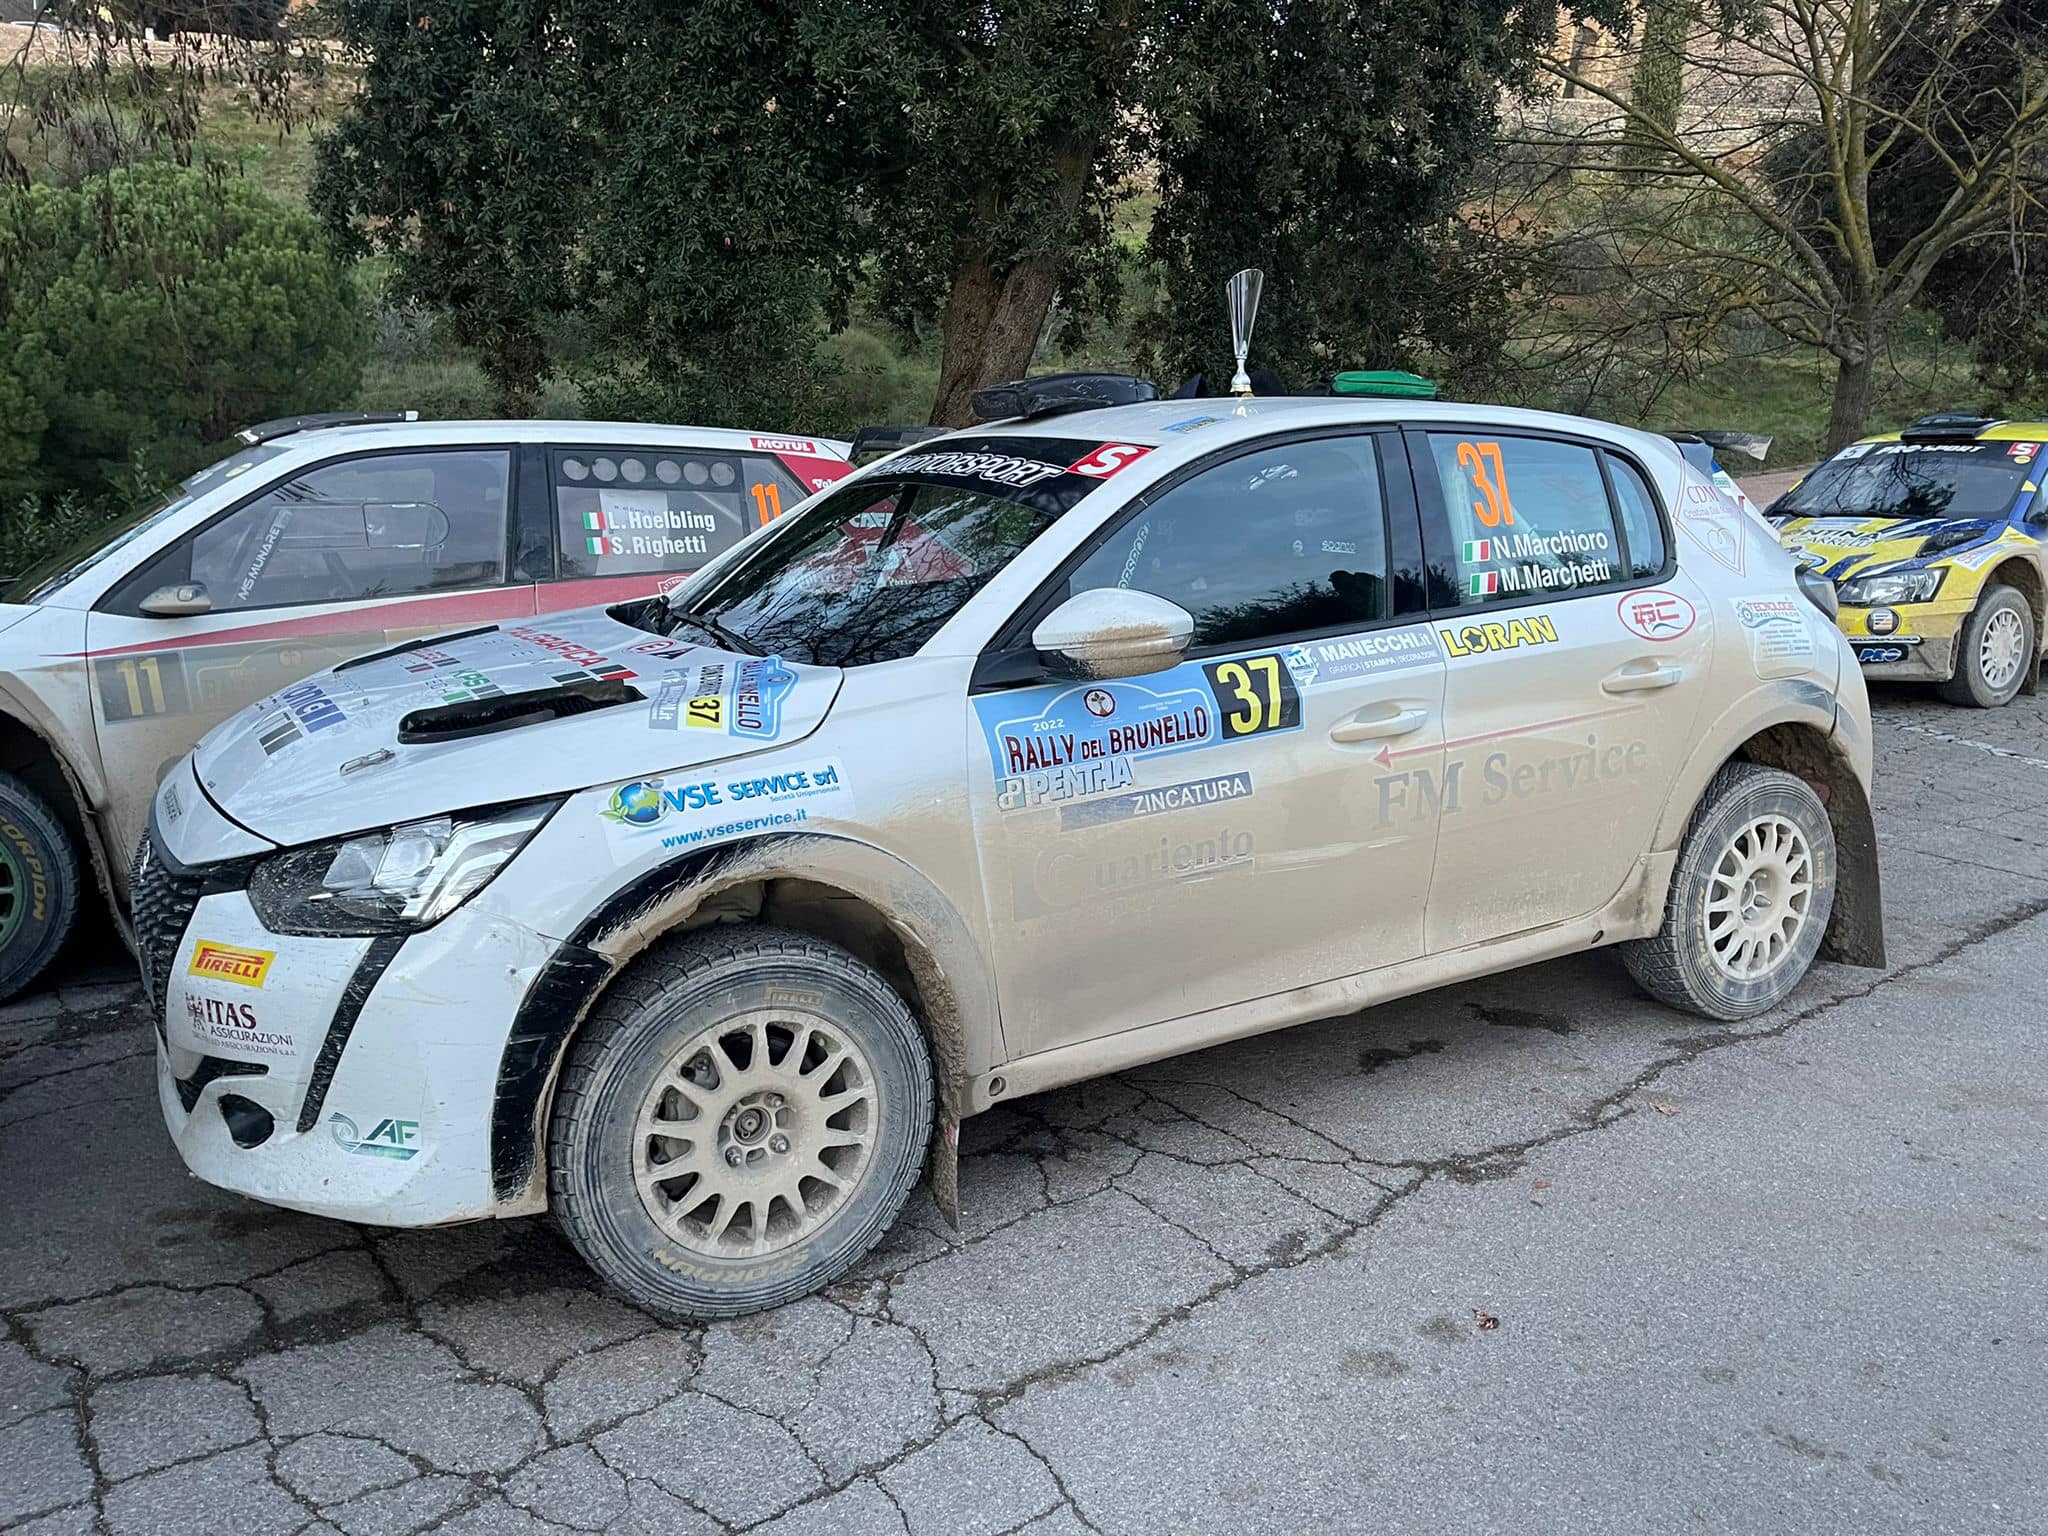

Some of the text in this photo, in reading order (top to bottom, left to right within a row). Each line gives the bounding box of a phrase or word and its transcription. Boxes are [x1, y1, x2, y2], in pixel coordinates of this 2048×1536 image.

[757, 440, 811, 452] MOTUL
[751, 483, 783, 527] 11
[1457, 442, 1515, 527] 37
[1440, 615, 1559, 658] LORAN
[115, 656, 167, 717] 11
[1216, 656, 1282, 734] 37
[688, 698, 721, 724] 37
[1032, 718, 1065, 733] 2022
[1005, 706, 1209, 774] RALLY DEL BRUNELLO
[663, 764, 839, 813] VSE SERVICE srl
[1131, 777, 1247, 815] ZINCATURA
[1373, 733, 1649, 830] FM Service
[661, 808, 808, 849] www.vseservice.it
[0, 815, 48, 922] ORPION
[195, 947, 265, 979] PIRELLI
[205, 998, 257, 1030] ITAS
[209, 1025, 294, 1046] ASSICURAZIONI
[365, 1118, 420, 1145] AF
